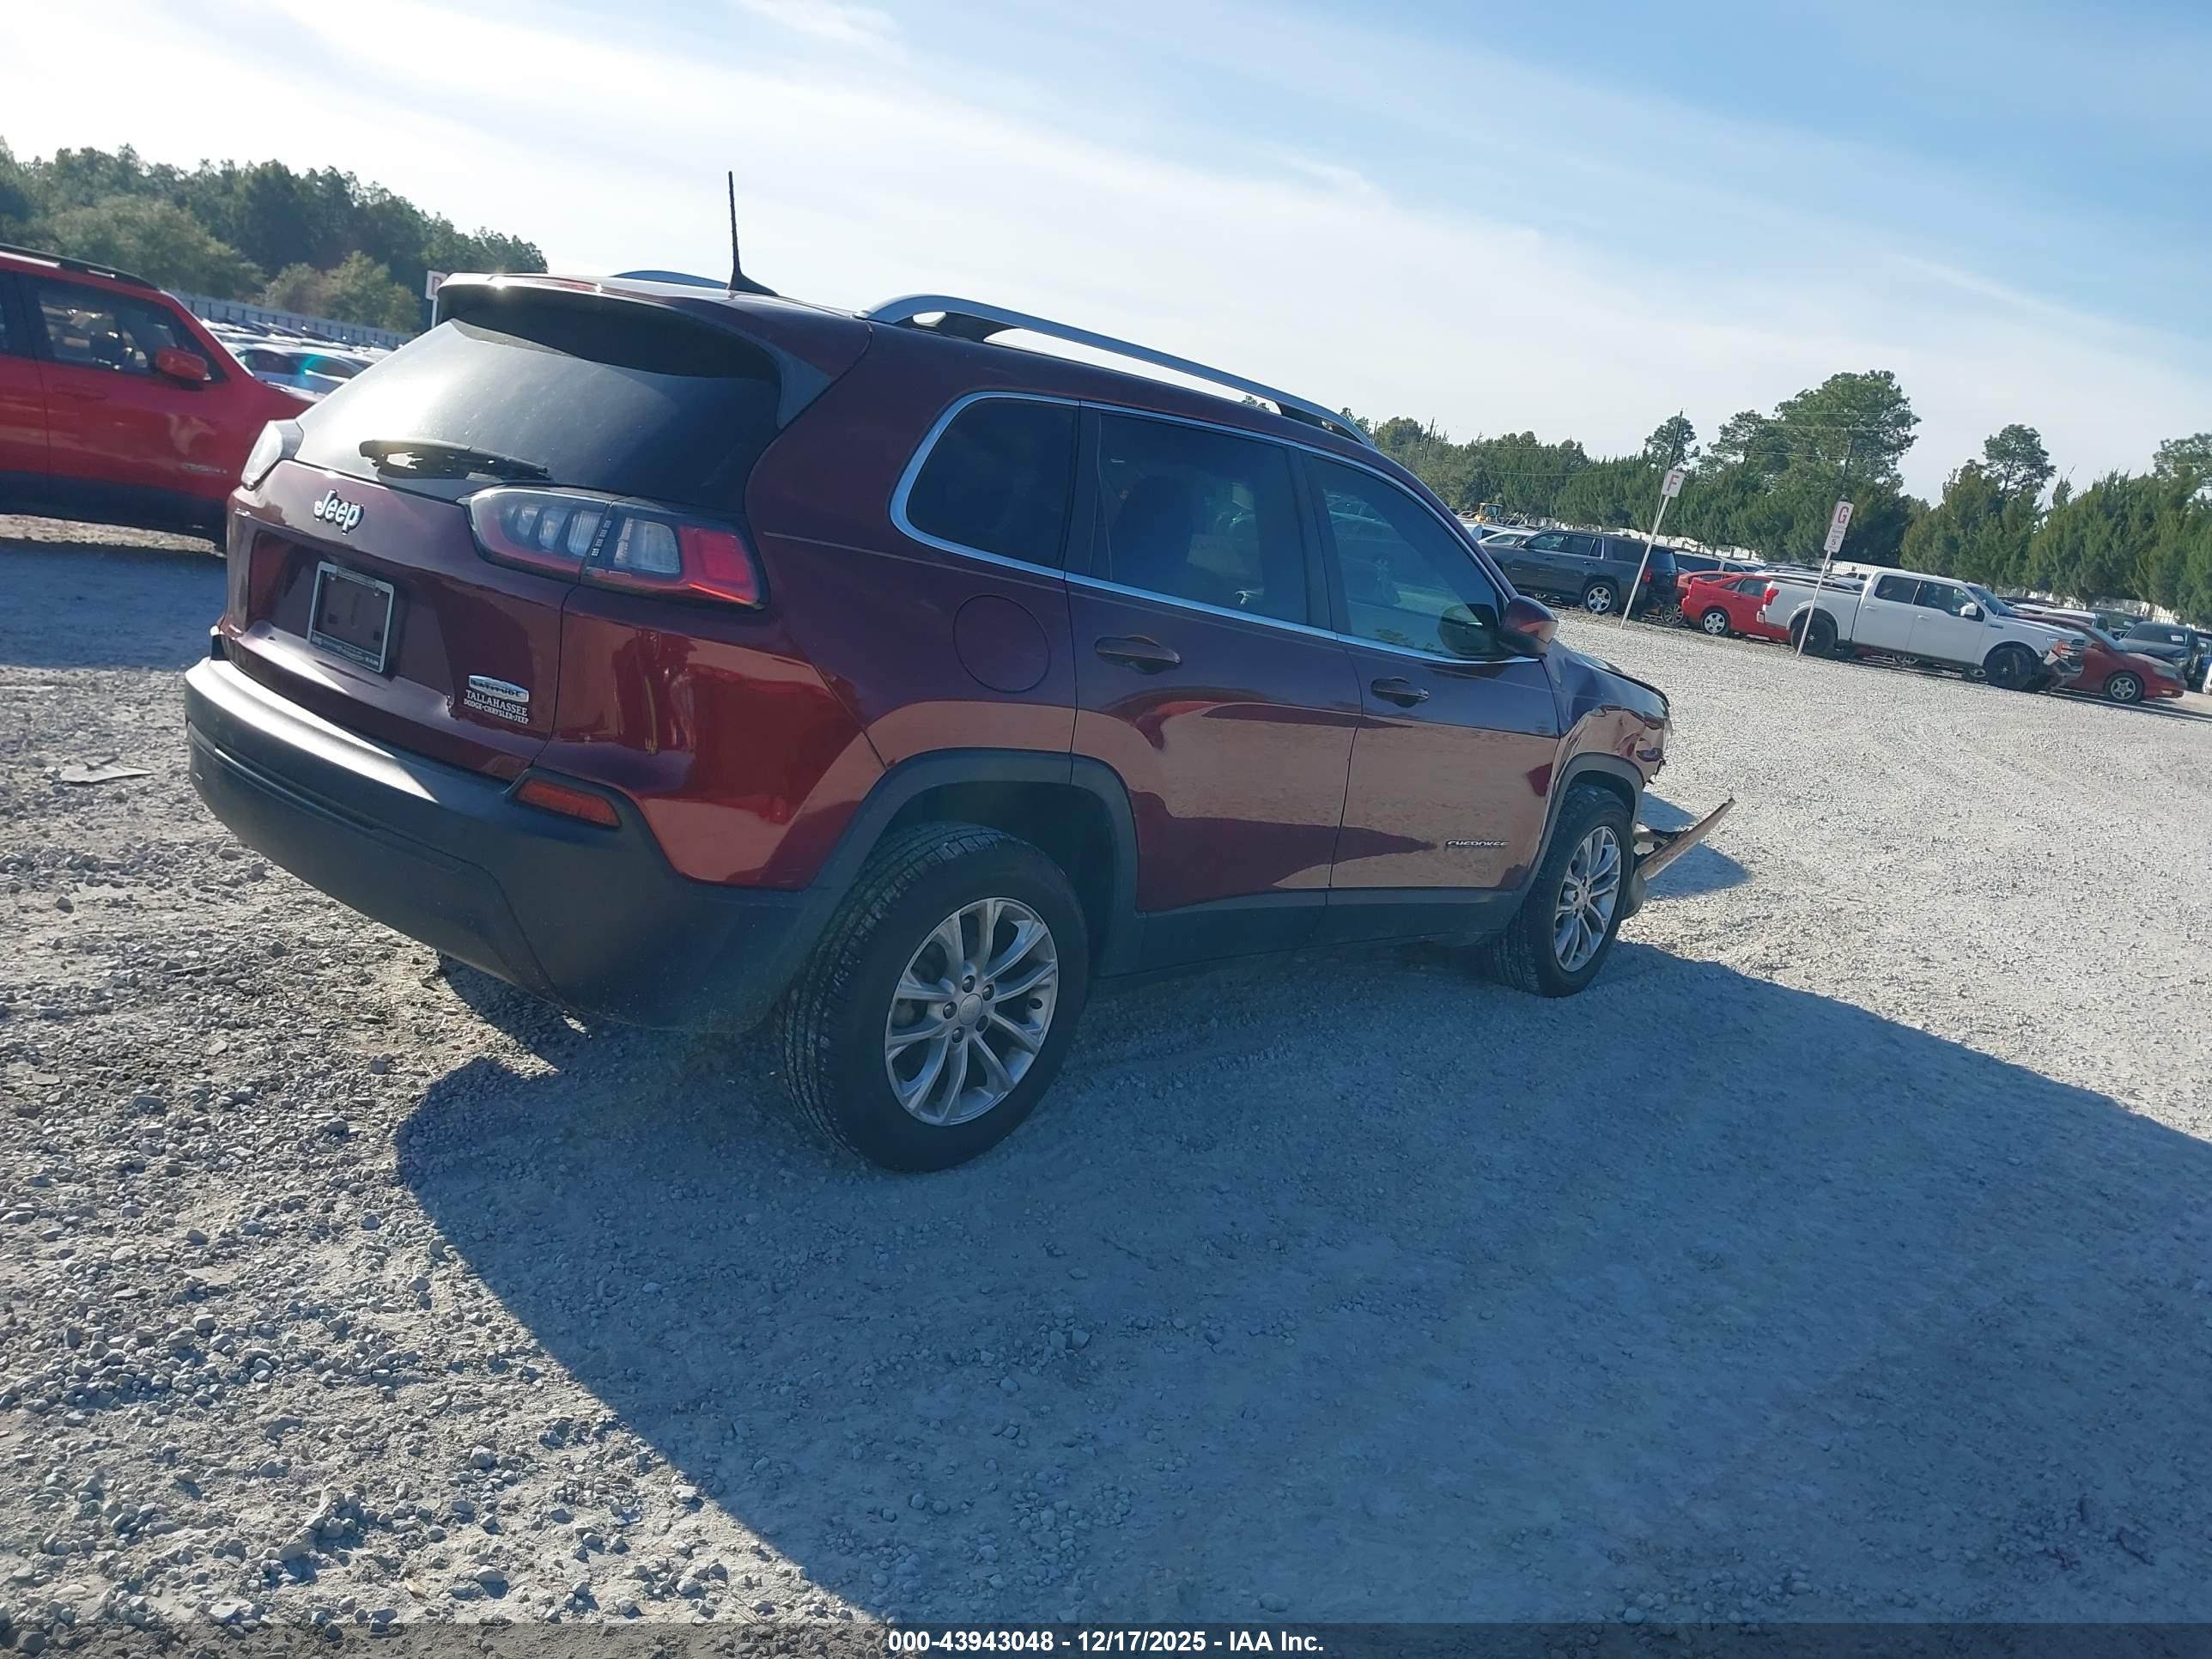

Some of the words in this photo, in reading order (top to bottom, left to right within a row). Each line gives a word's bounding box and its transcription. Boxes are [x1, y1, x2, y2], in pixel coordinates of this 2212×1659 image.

[1667, 474, 1680, 491] F
[313, 489, 364, 535] Jeep
[1838, 506, 1850, 524] G
[465, 689, 528, 717] TALLAHASSEE
